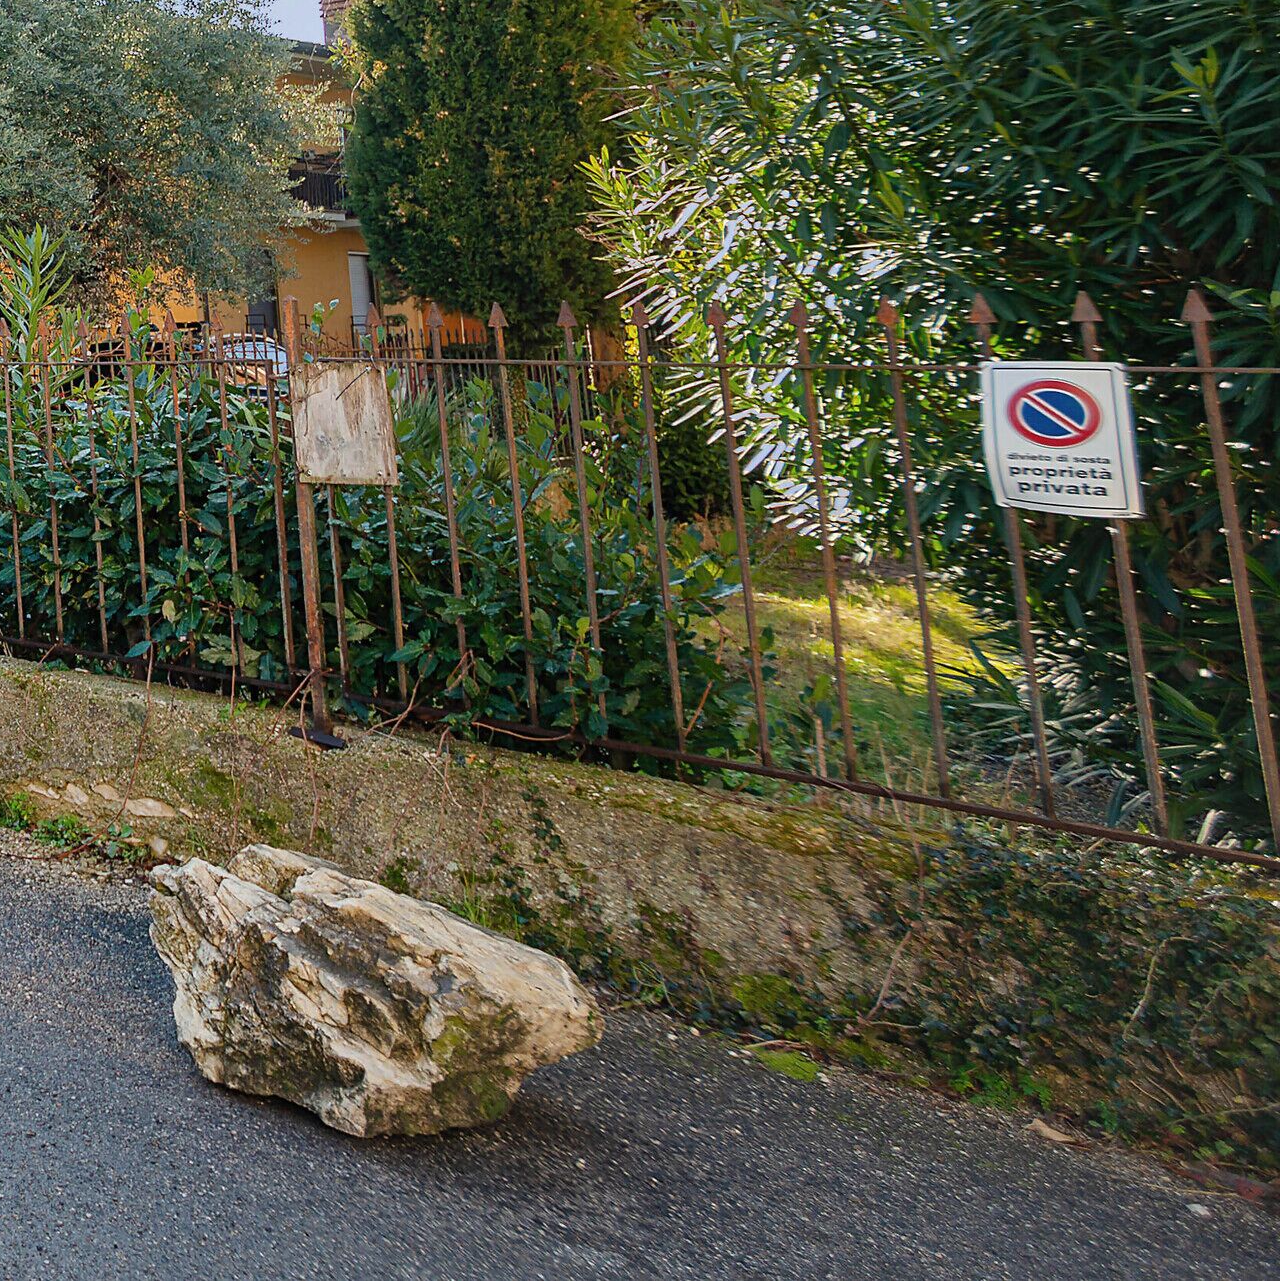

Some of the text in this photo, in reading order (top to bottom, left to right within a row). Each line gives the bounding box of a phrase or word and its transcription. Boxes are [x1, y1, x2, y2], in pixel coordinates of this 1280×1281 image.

[1007, 452, 1111, 465] divieto di sosta
[1008, 466, 1113, 480] proprietà
[1017, 480, 1109, 497] privata
